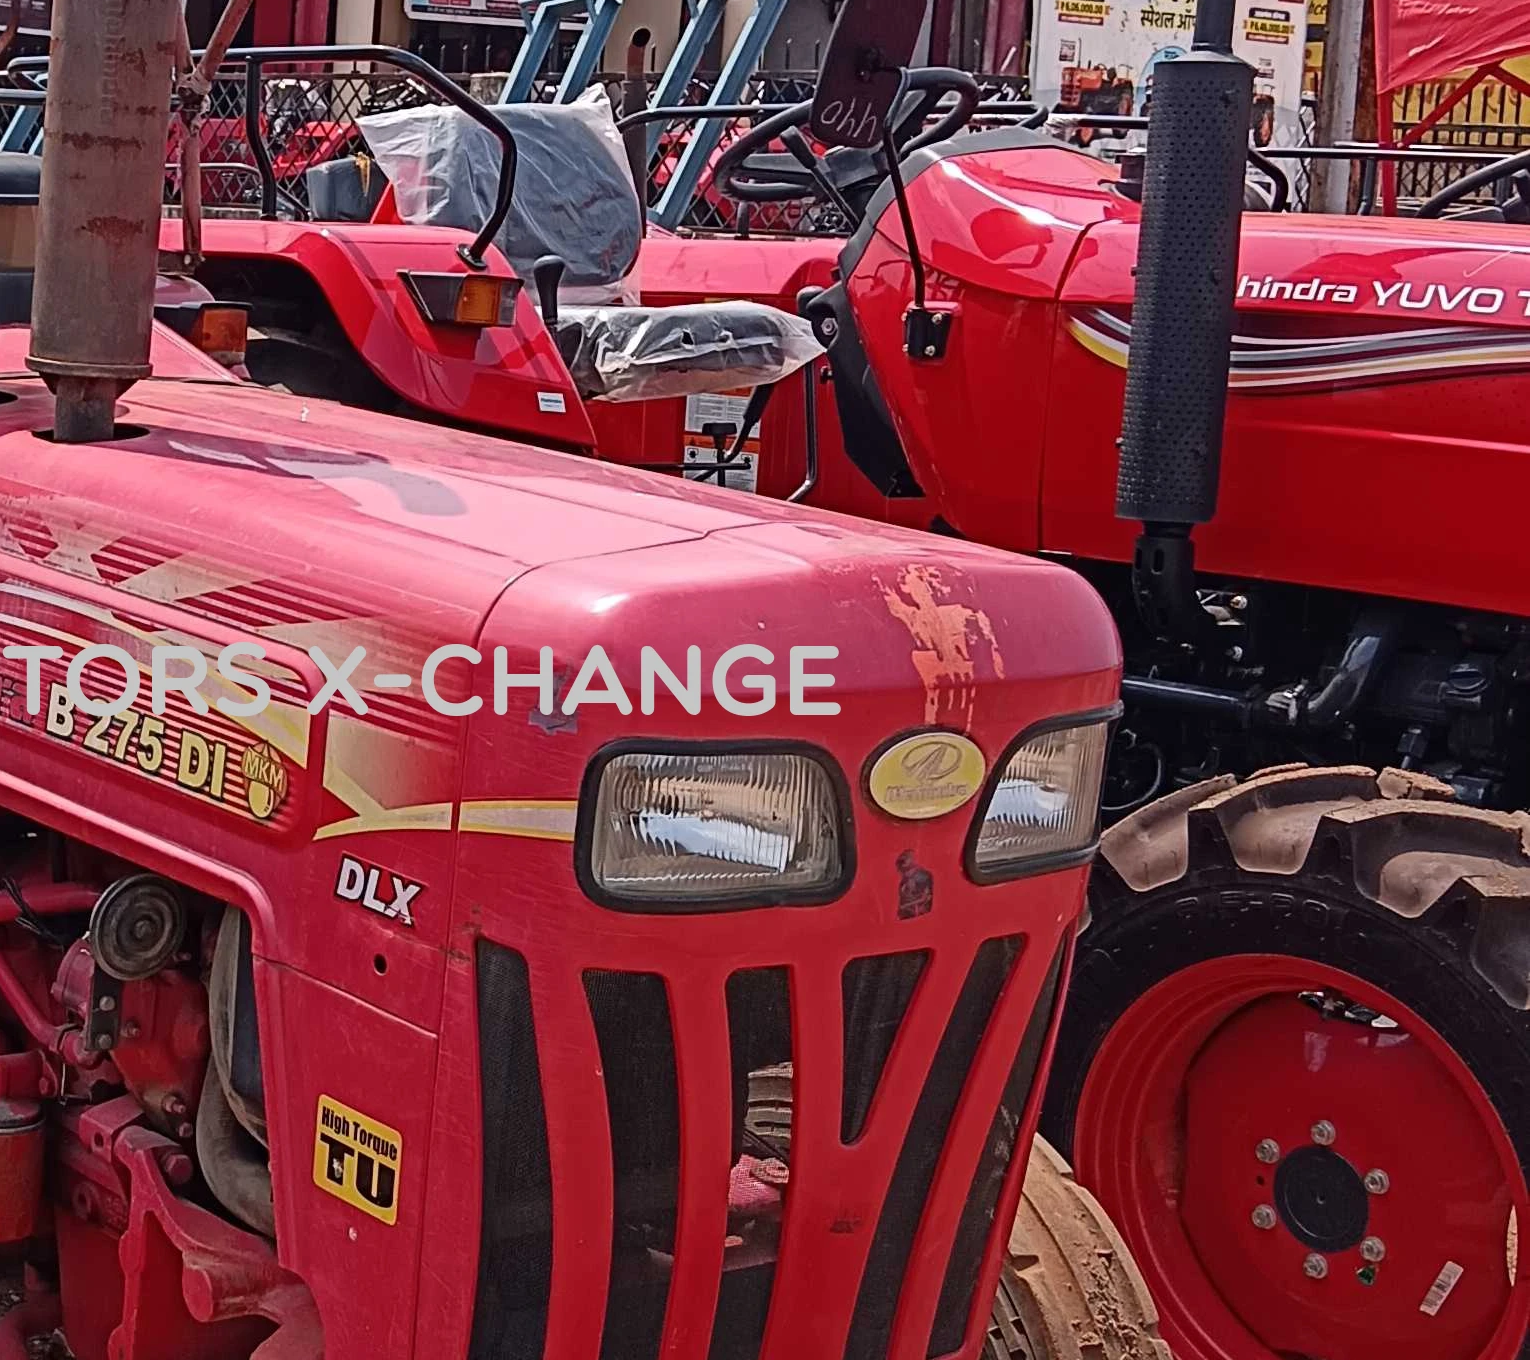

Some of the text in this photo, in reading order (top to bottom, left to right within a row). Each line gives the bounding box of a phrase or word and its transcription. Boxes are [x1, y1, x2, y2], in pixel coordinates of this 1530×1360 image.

[1140, 4, 1175, 29] स्पेशल
[1236, 274, 1359, 305] hindra
[1372, 279, 1506, 315] YUVO
[45, 681, 227, 801] B 275 DI
[244, 746, 284, 791] MKM
[336, 856, 423, 926] DLX
[321, 1105, 398, 1162] High Torque
[320, 1132, 396, 1209] TU
